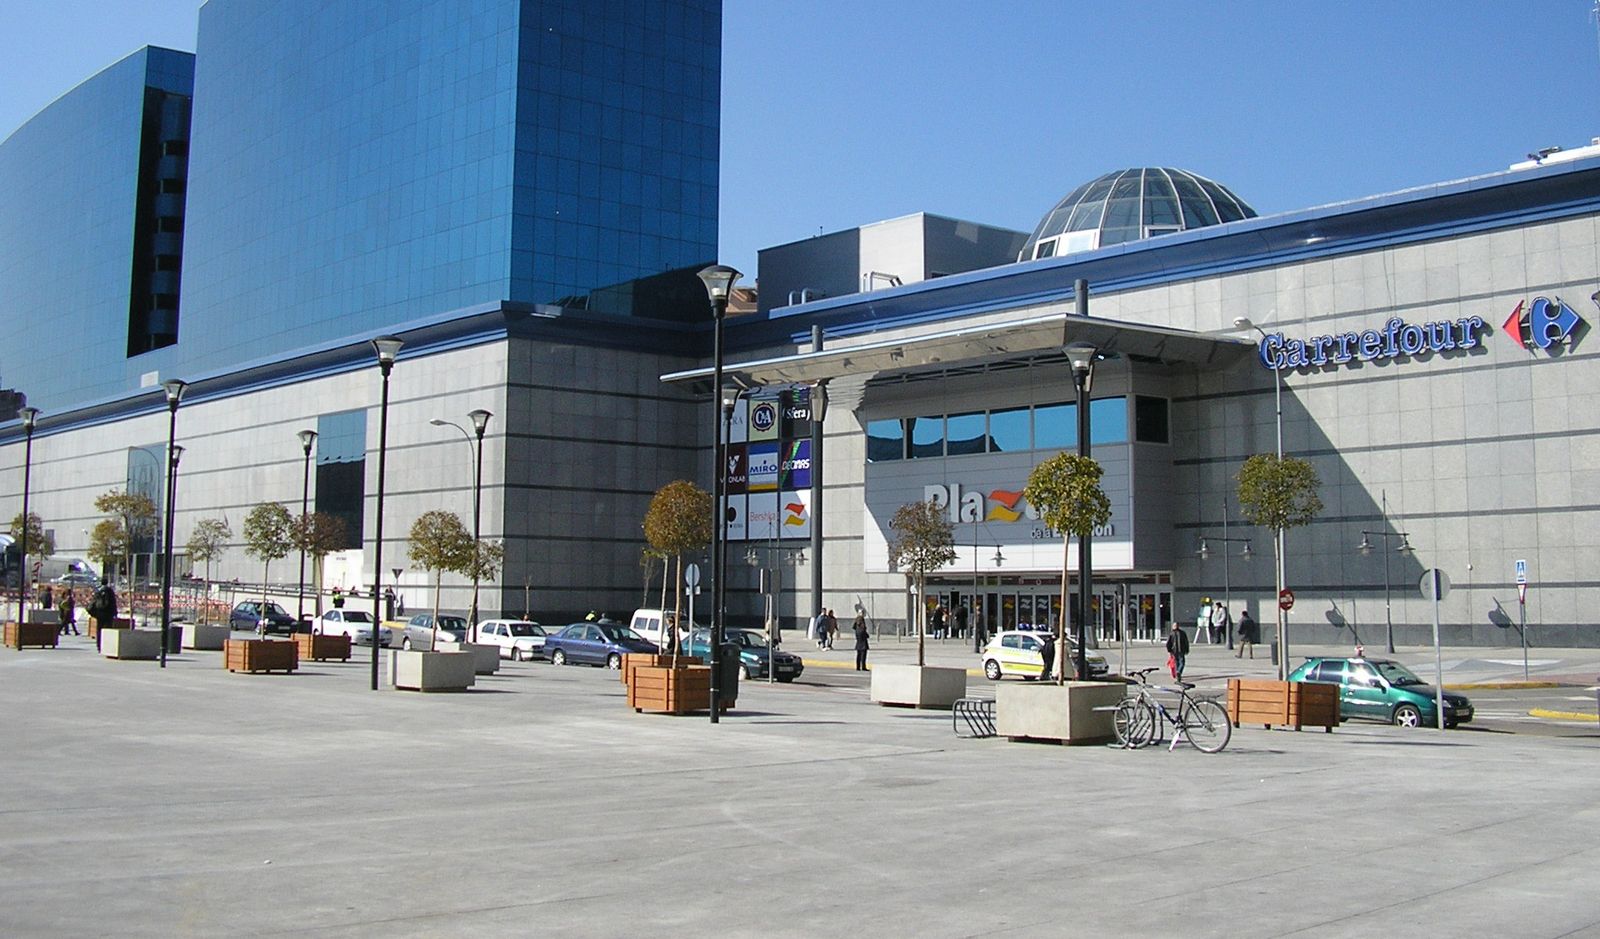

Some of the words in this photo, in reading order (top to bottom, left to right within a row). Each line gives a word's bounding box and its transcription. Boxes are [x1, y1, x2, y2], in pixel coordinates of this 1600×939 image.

[1258, 315, 1482, 370] Carrefour
[722, 415, 744, 426] RA
[755, 410, 772, 424] C&A
[1031, 528, 1041, 539] de
